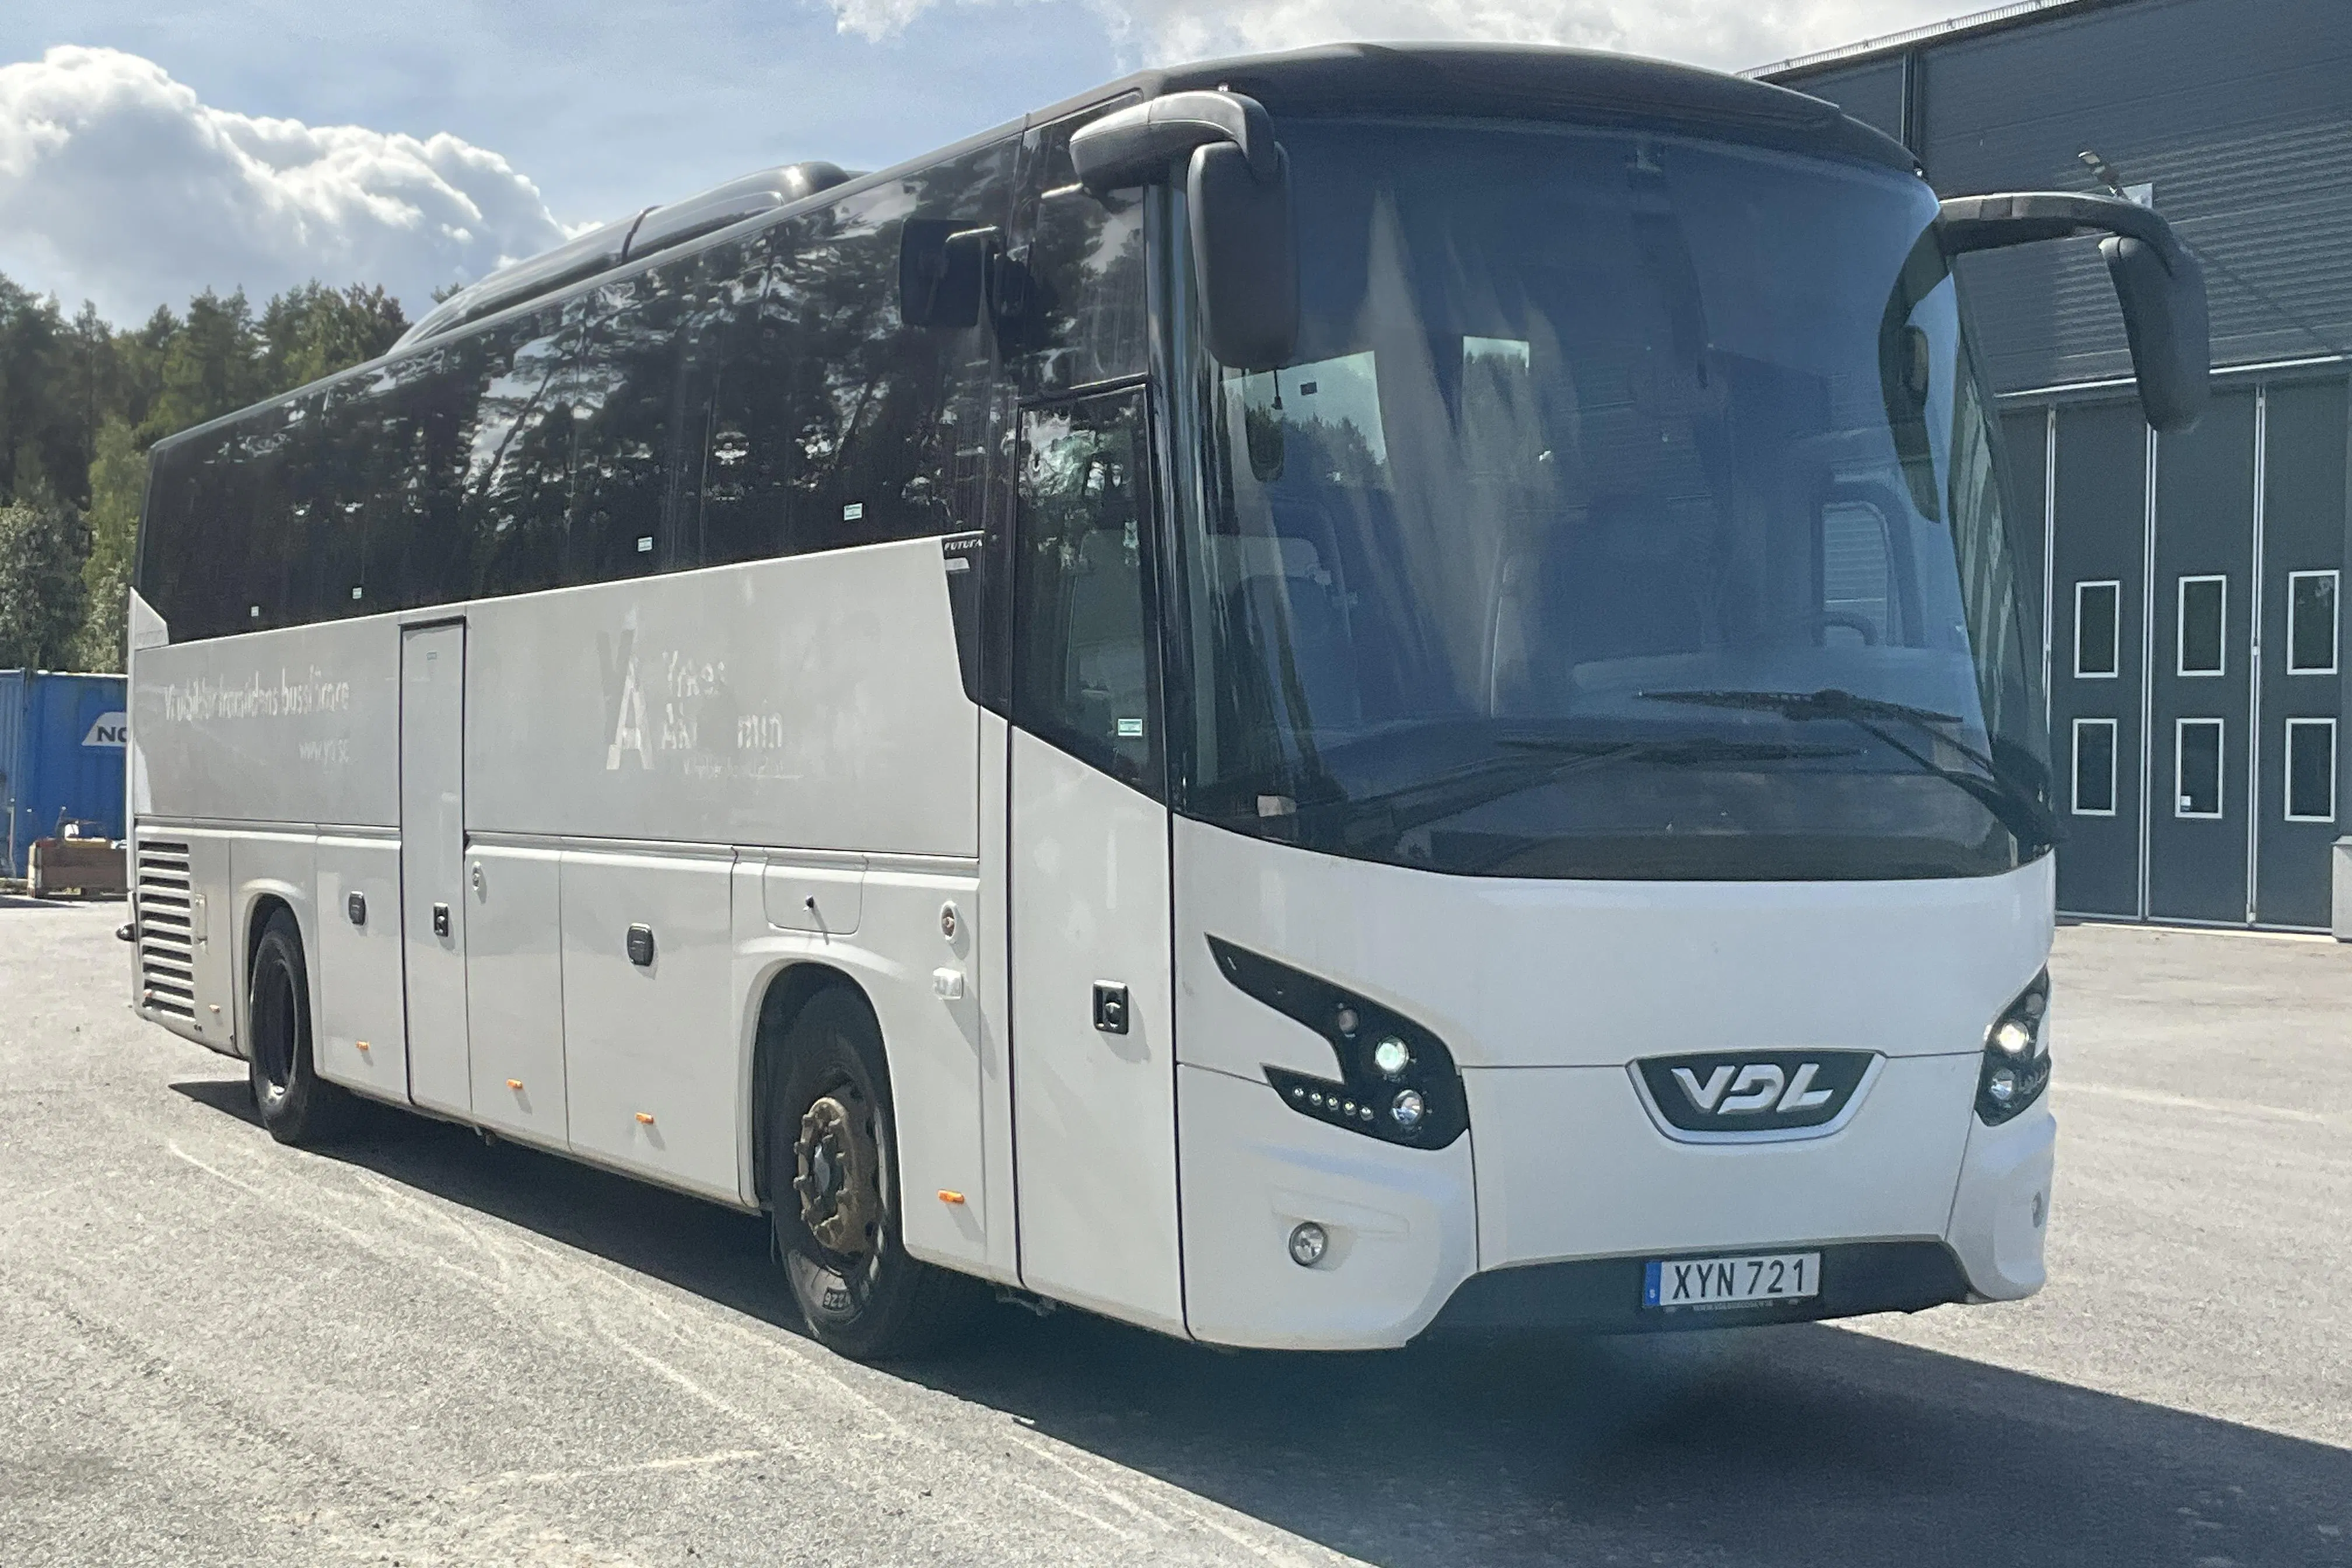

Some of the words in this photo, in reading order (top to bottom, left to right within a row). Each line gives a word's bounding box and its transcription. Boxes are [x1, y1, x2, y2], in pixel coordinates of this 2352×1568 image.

[1671, 1063, 1834, 1115] VDL
[1672, 1262, 1735, 1300] XYN
[1746, 1258, 1804, 1296] 721
